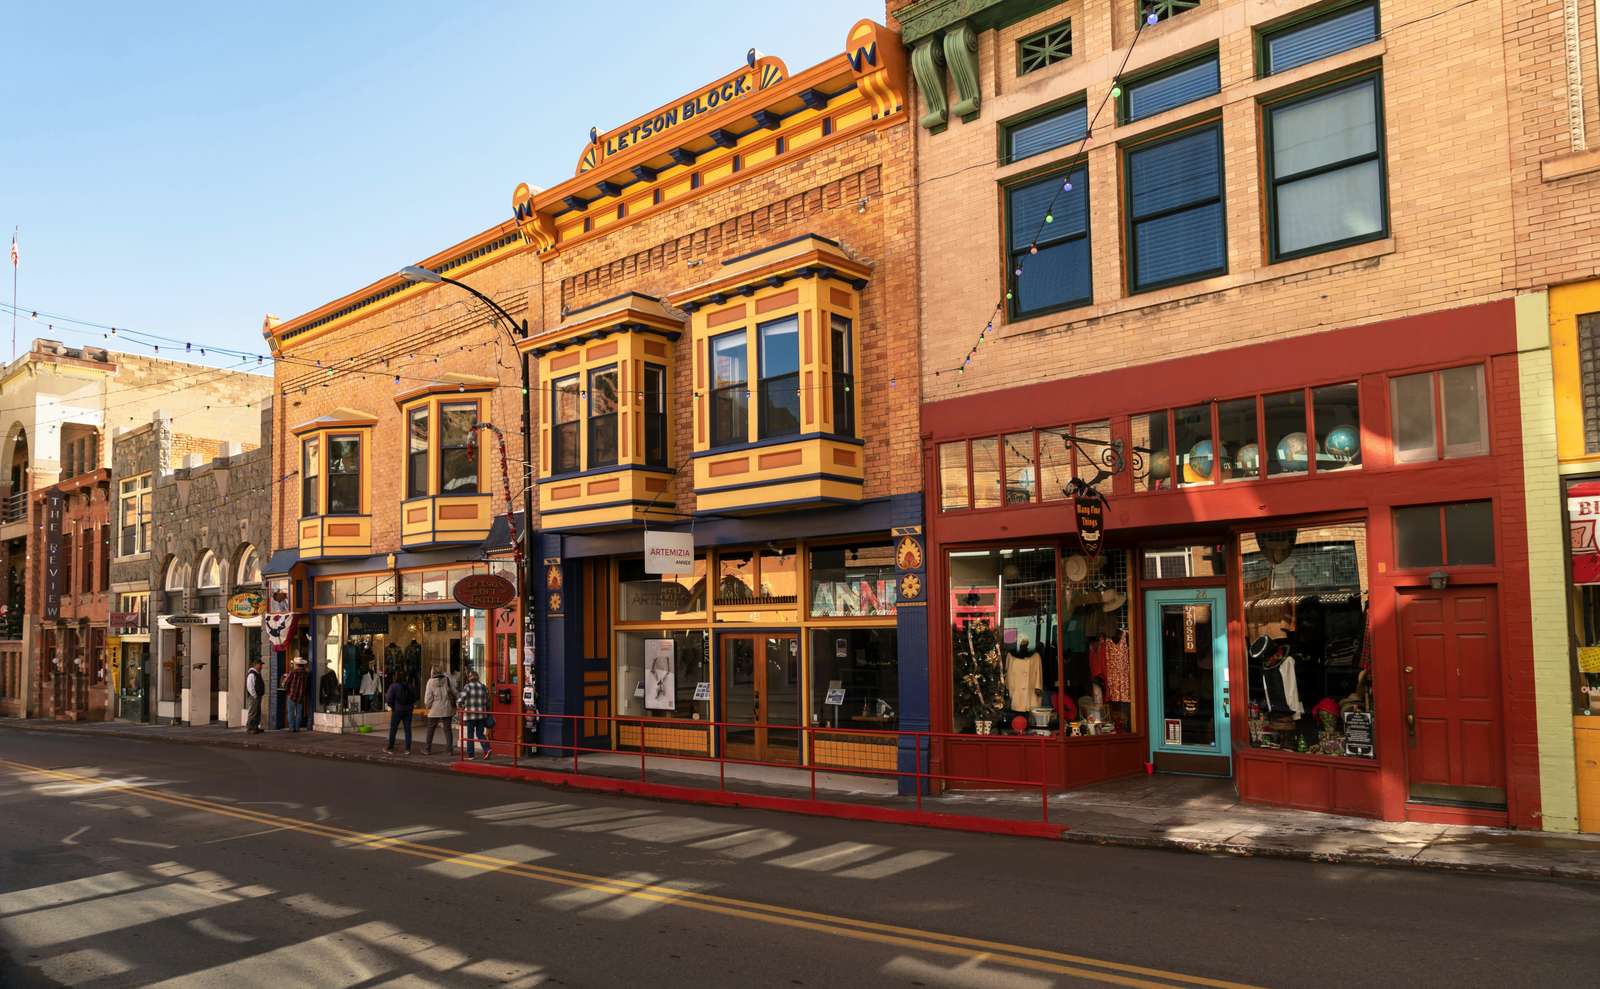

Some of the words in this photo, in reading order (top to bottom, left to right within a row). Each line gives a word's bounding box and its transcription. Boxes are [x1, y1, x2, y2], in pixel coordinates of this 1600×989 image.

[606, 105, 678, 156] LETSON
[682, 75, 752, 120] BLOCK.
[50, 497, 59, 532] THE
[48, 543, 59, 616] REVIEW
[650, 548, 690, 557] ARTEMIZIA
